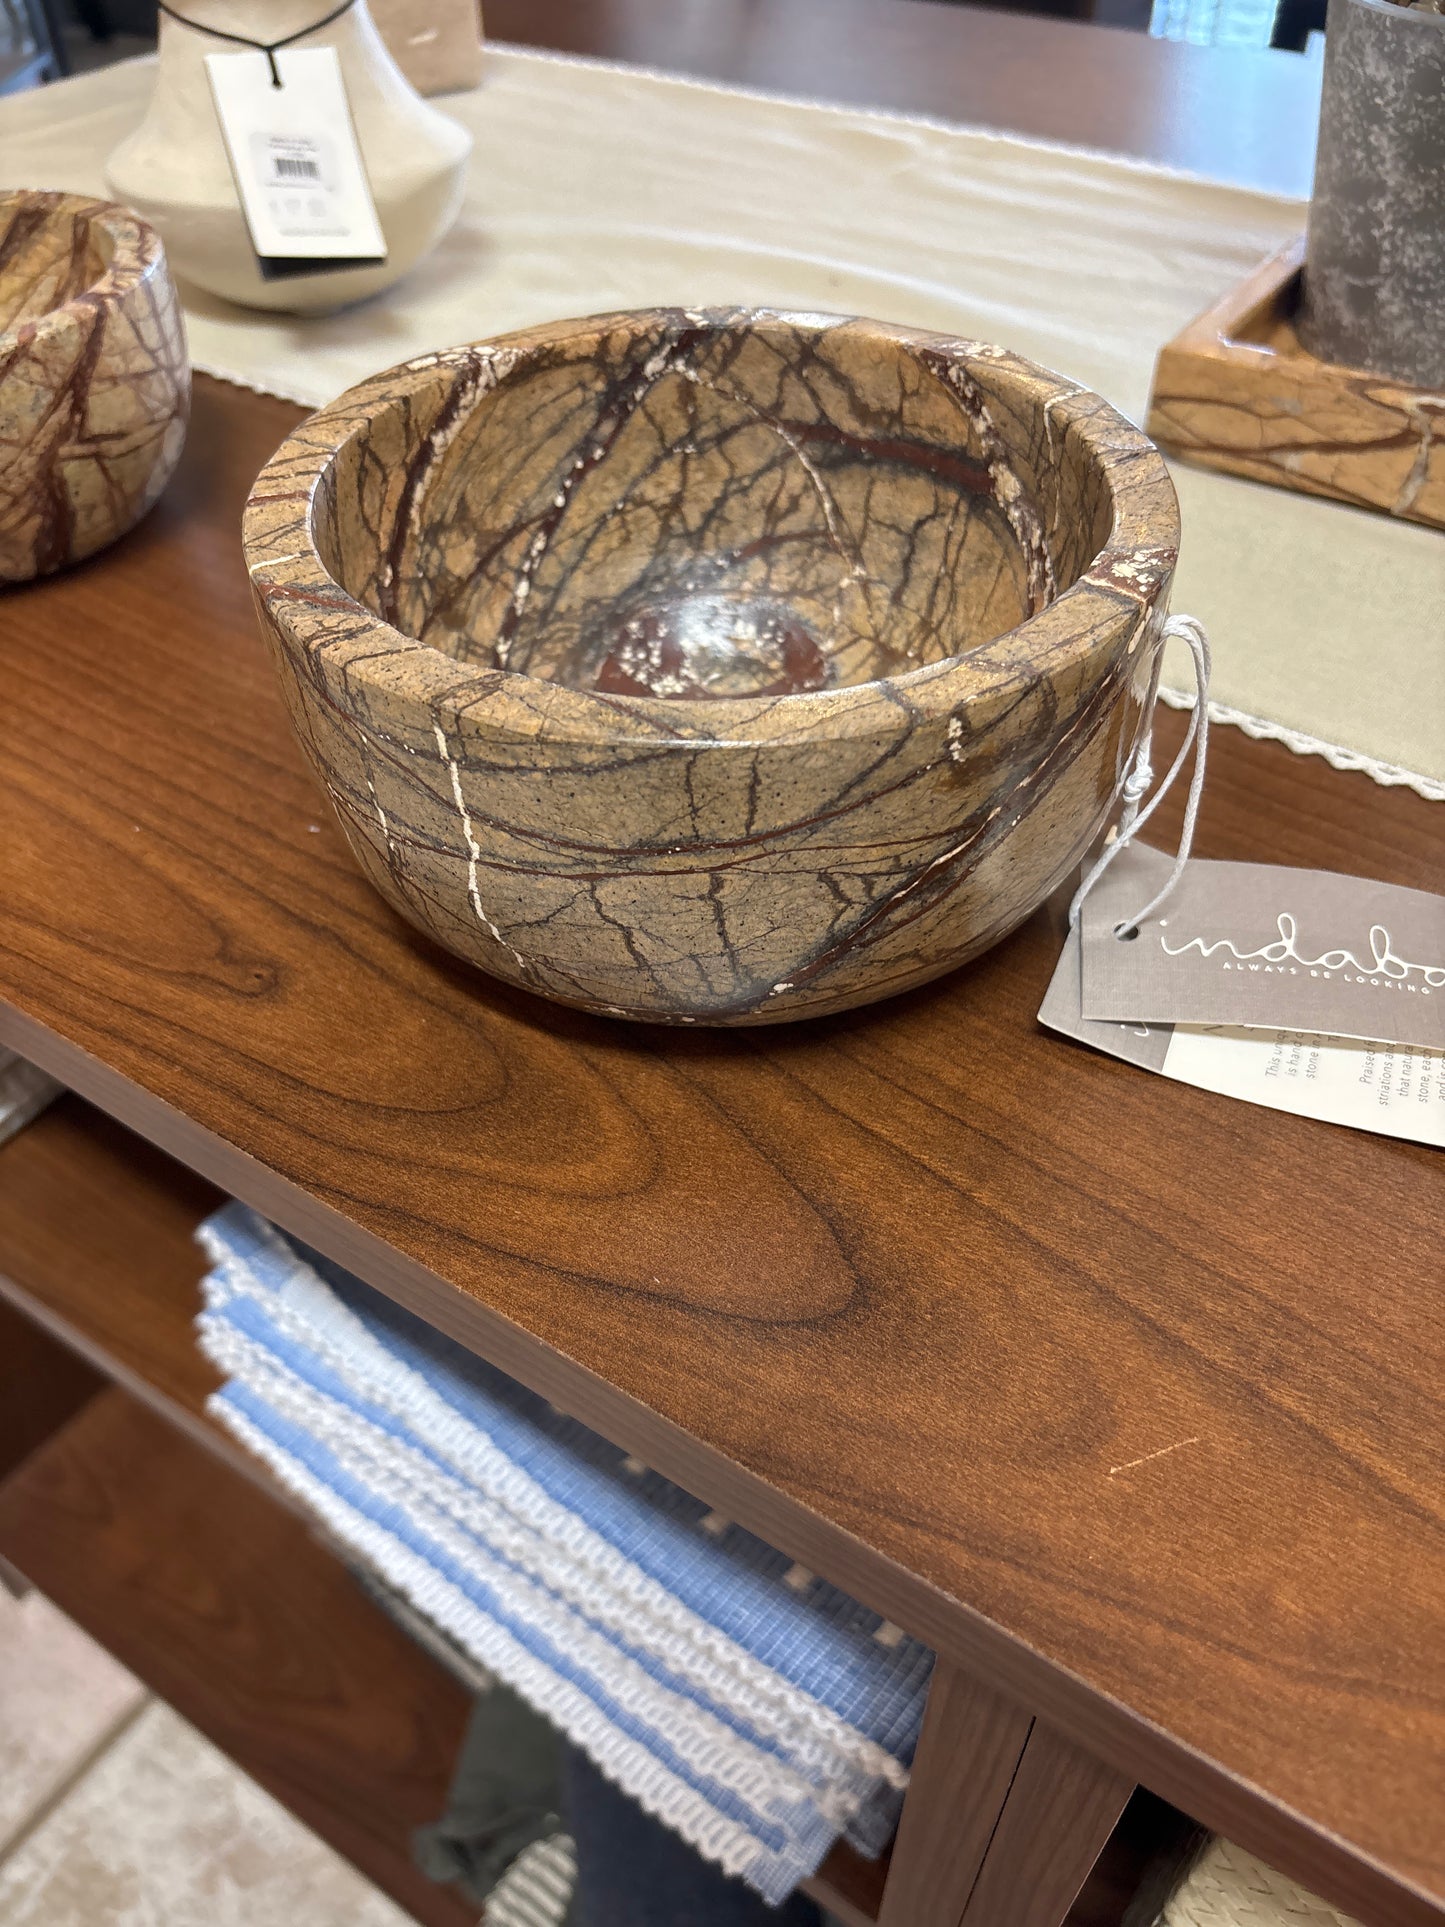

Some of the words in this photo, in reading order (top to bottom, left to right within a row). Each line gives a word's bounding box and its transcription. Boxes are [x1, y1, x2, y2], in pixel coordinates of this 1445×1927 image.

[1222, 961, 1297, 975] ALWAYS
[1310, 969, 1331, 979] BE
[1344, 974, 1430, 995] LOOKING
[1264, 1057, 1281, 1077] This
[1273, 1030, 1288, 1055] uniq
[1286, 1040, 1303, 1067] hand
[1310, 1040, 1321, 1050] in
[1285, 1067, 1297, 1077] is
[1306, 1052, 1319, 1079] stone
[1359, 1047, 1375, 1084] Praised
[1402, 1045, 1413, 1076] natura
[1377, 1062, 1393, 1106] striations
[1396, 1078, 1410, 1097] that
[1417, 1074, 1433, 1103] stone,
